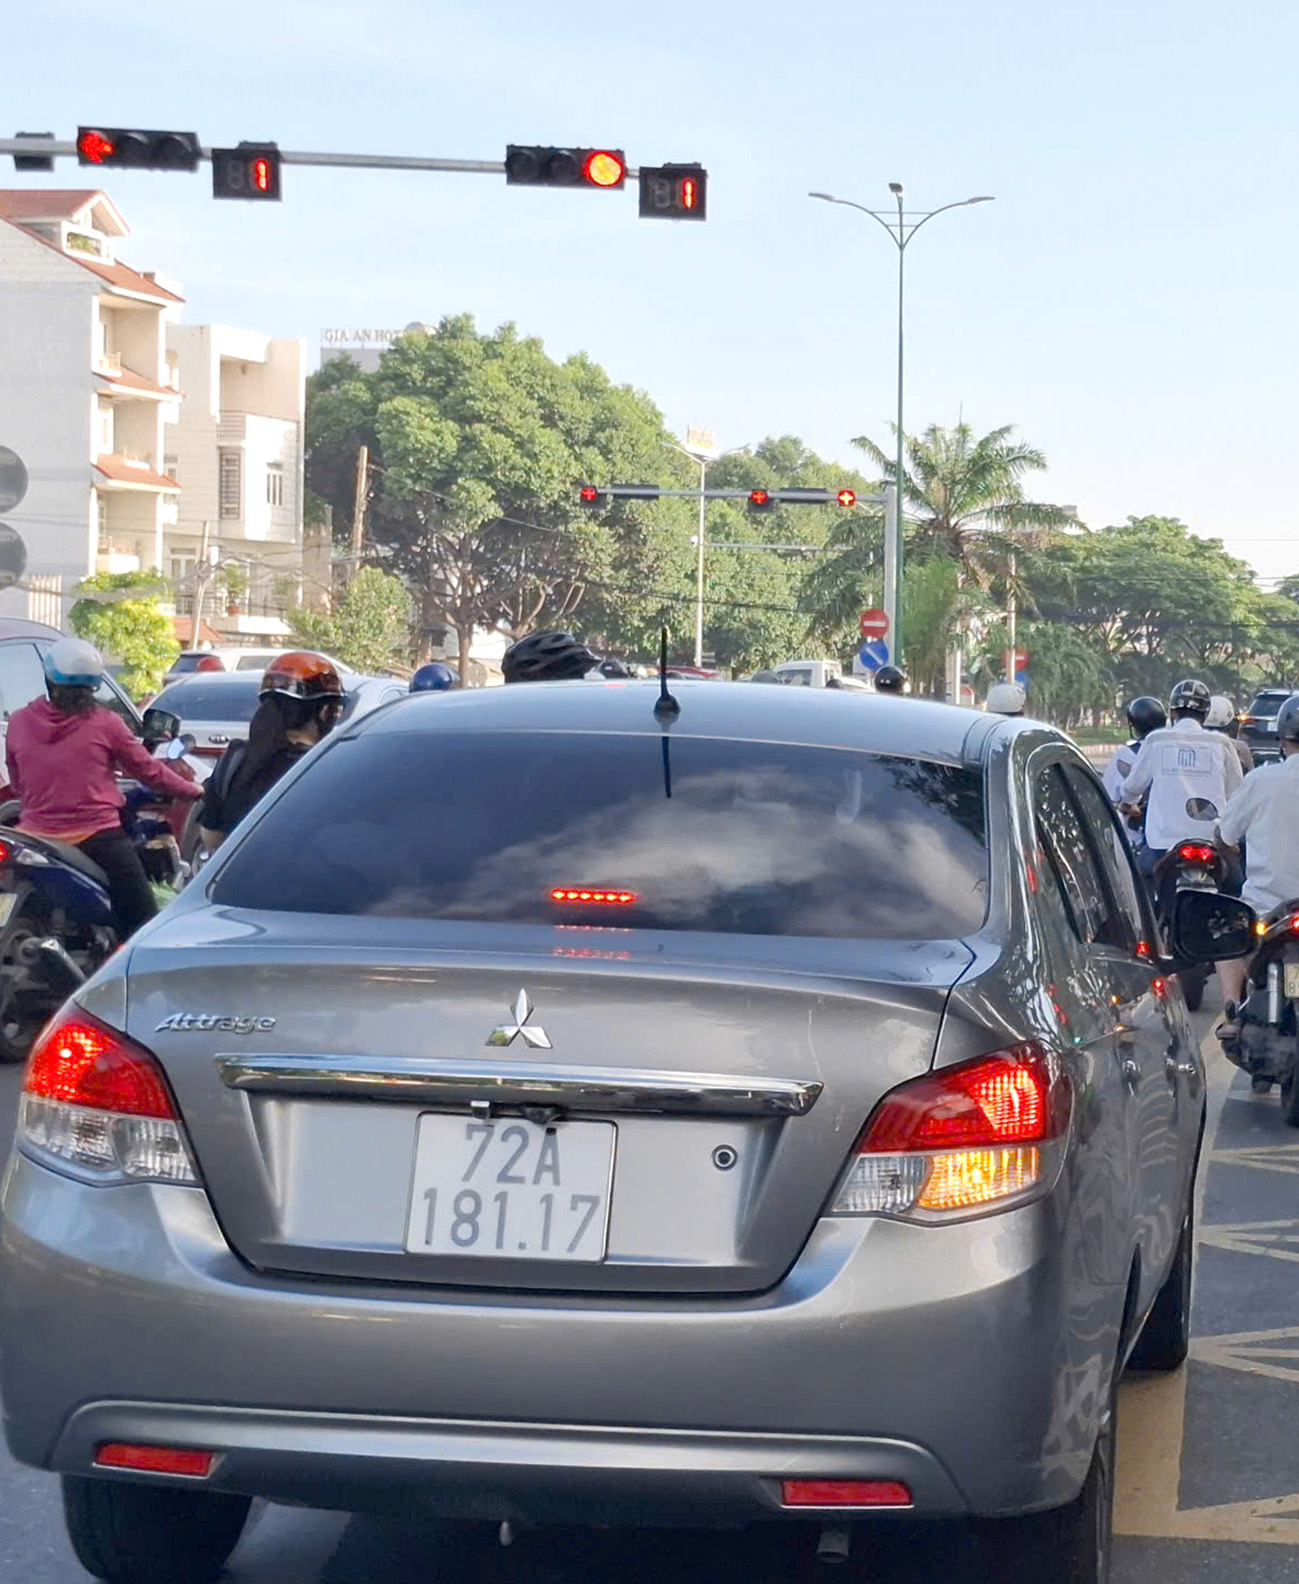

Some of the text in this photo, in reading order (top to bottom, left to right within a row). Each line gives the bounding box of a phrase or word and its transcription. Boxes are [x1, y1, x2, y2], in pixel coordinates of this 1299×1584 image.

[325, 330, 348, 341] GIA
[375, 329, 404, 341] HOT
[155, 1013, 277, 1034] Attrage
[462, 1123, 561, 1186] 72A
[424, 1187, 600, 1253] 181.17
